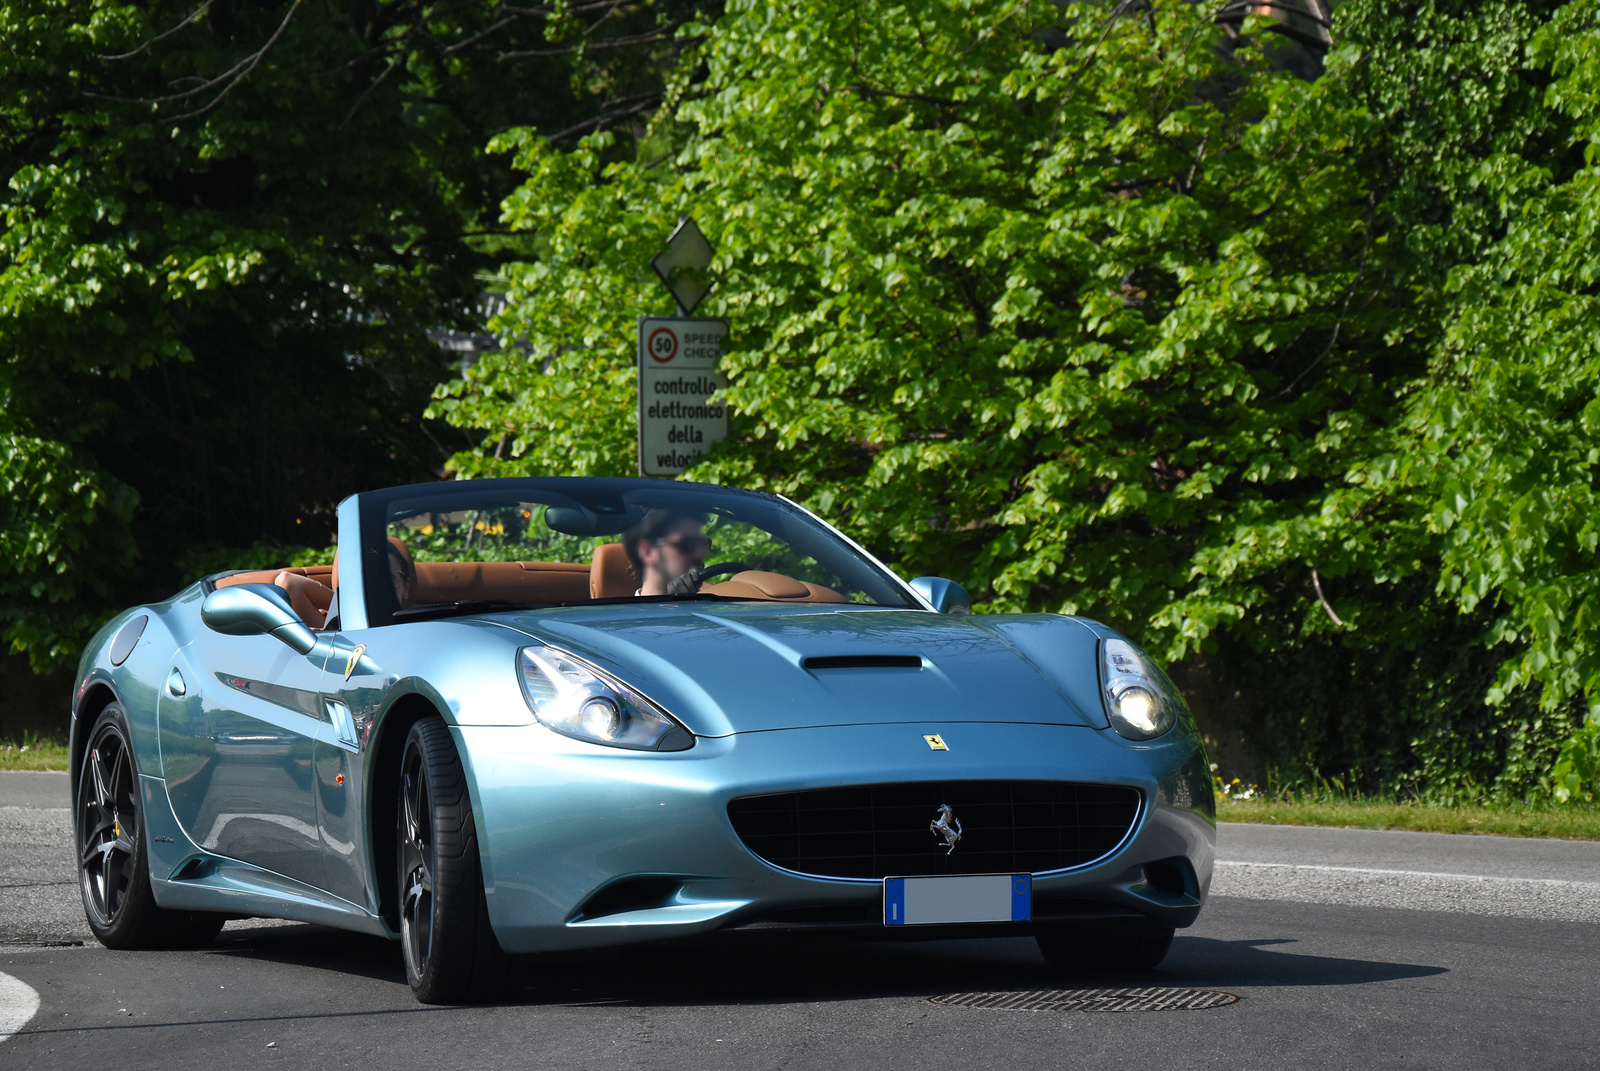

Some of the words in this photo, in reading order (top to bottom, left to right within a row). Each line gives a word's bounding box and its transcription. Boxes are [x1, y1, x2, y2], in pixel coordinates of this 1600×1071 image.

[655, 337, 672, 353] 50
[684, 333, 723, 344] SPEED
[684, 347, 721, 358] CHECK
[654, 376, 717, 395] controllo
[648, 401, 723, 419] elettronico
[668, 424, 703, 443] della
[656, 448, 702, 468] veloc
